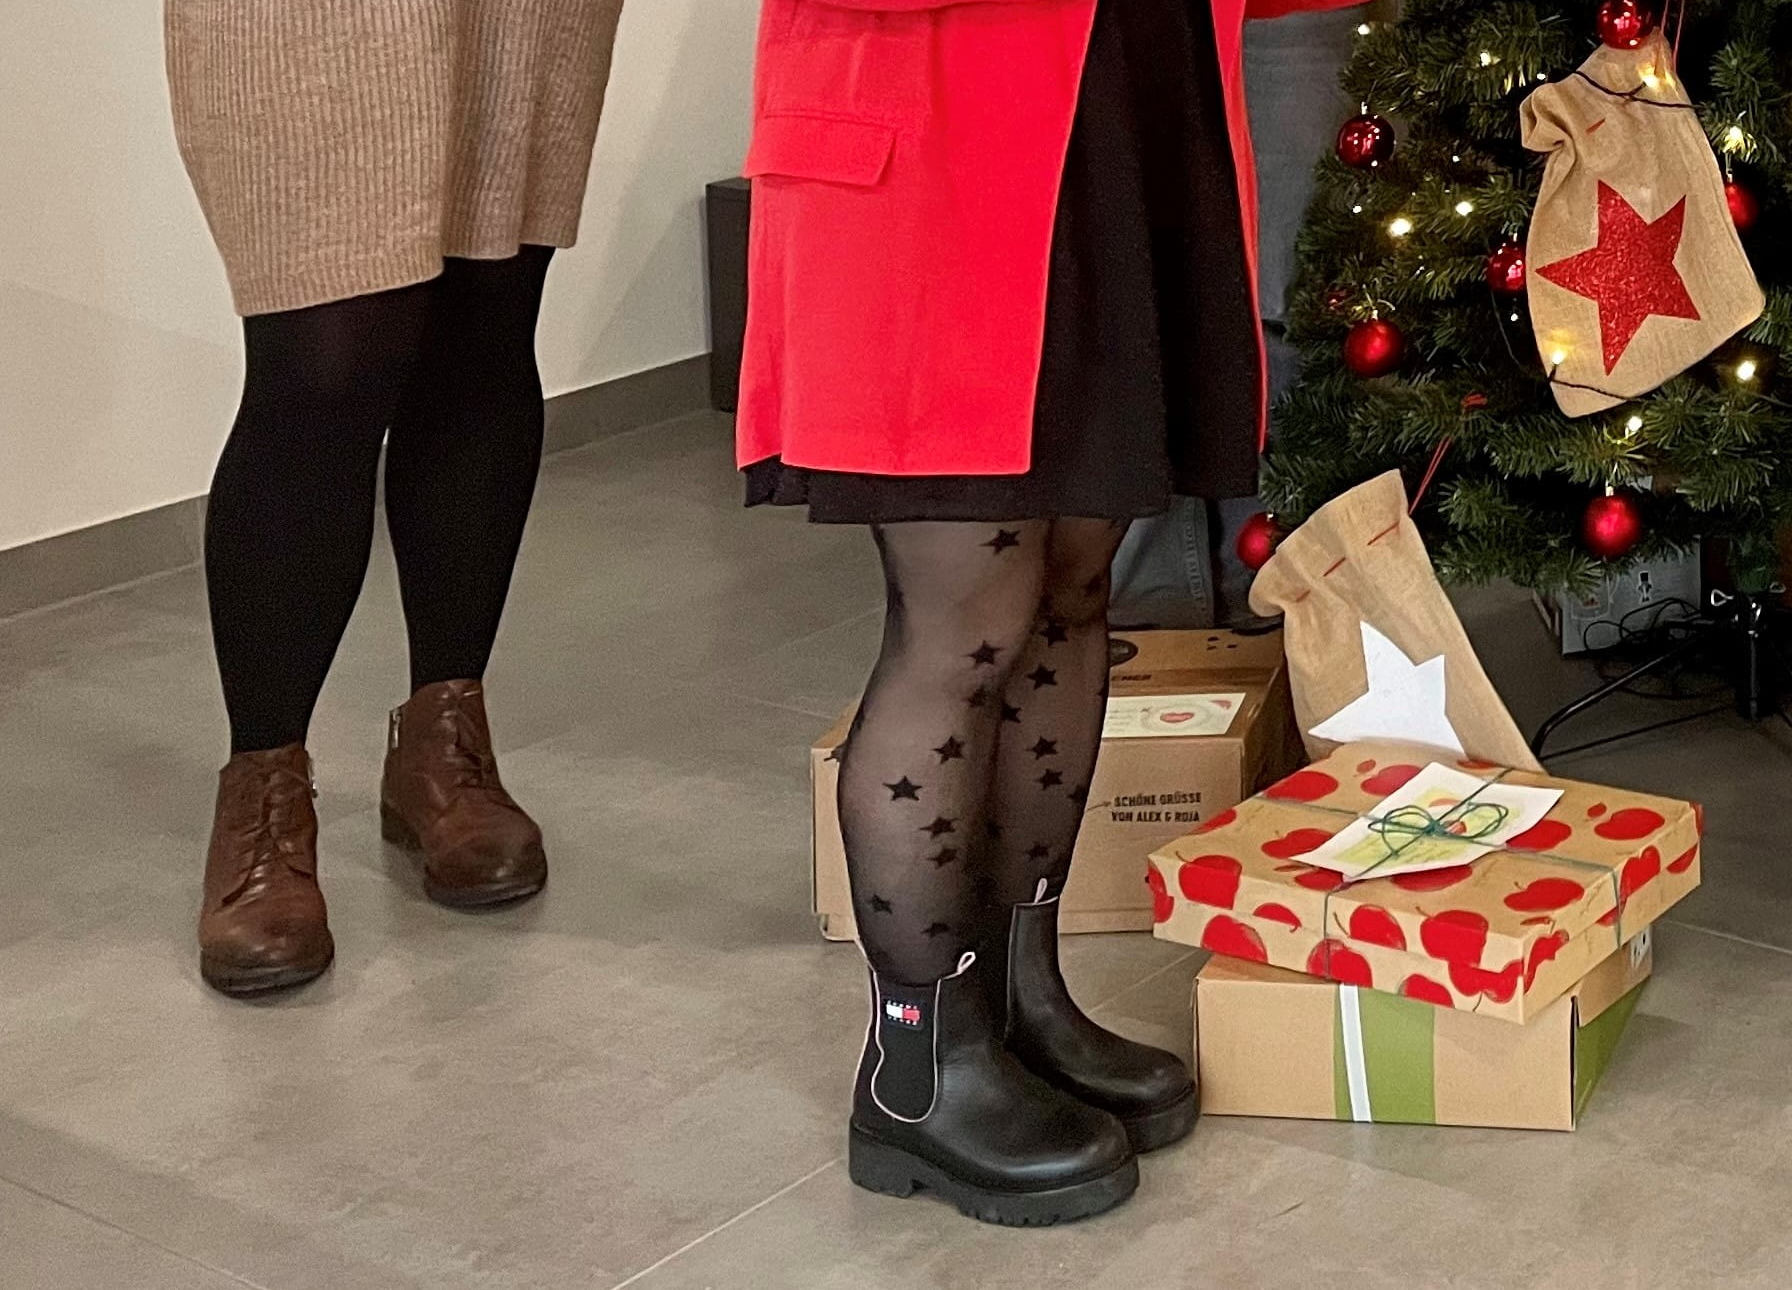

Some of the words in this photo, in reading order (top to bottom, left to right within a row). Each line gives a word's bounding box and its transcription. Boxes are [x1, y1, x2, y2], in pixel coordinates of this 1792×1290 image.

[1114, 792, 1156, 807] SCHÖNE
[1160, 790, 1201, 805] GRÜSSE
[1112, 812, 1133, 822] VON
[1136, 811, 1161, 822] ALEX
[1175, 811, 1200, 822] ROJA
